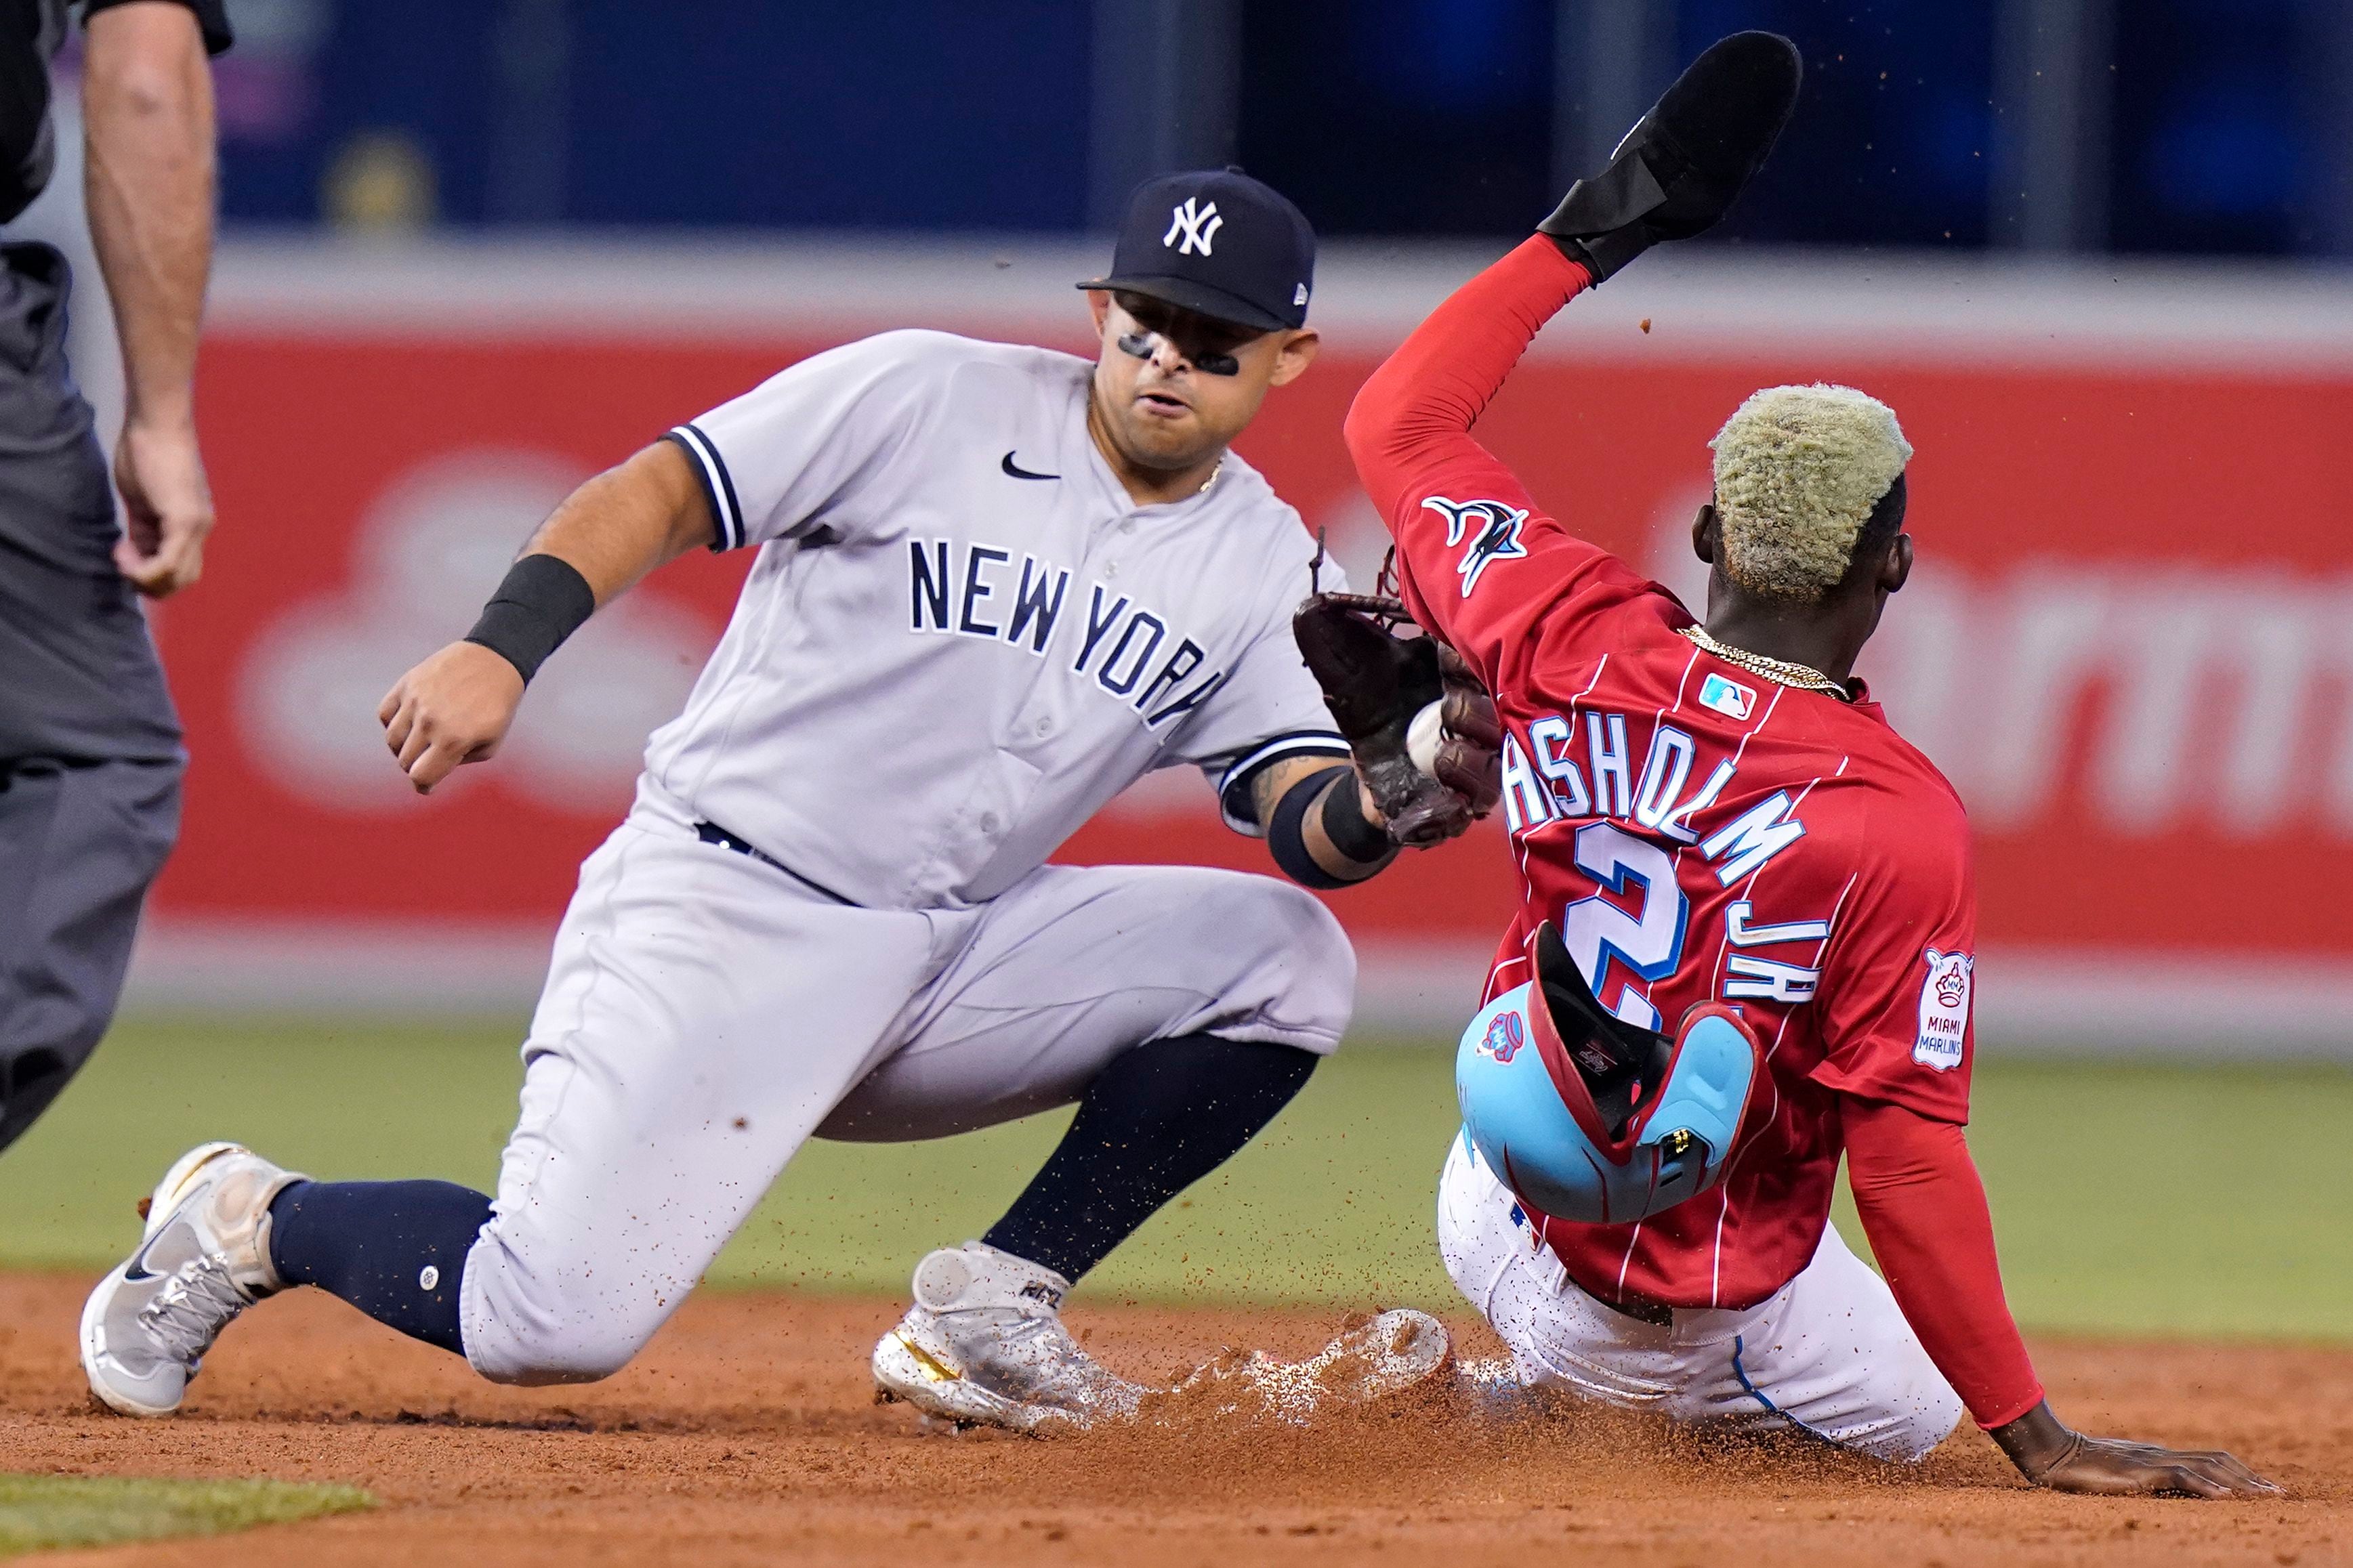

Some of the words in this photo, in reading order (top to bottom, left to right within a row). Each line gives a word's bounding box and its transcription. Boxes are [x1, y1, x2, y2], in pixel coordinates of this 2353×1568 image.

[1163, 196, 1224, 257] NY
[907, 538, 1073, 656] NEW
[1564, 820, 1690, 1033] 2
[1919, 1036, 1961, 1056] MARLINS
[1928, 1017, 1961, 1035] MIAMI
